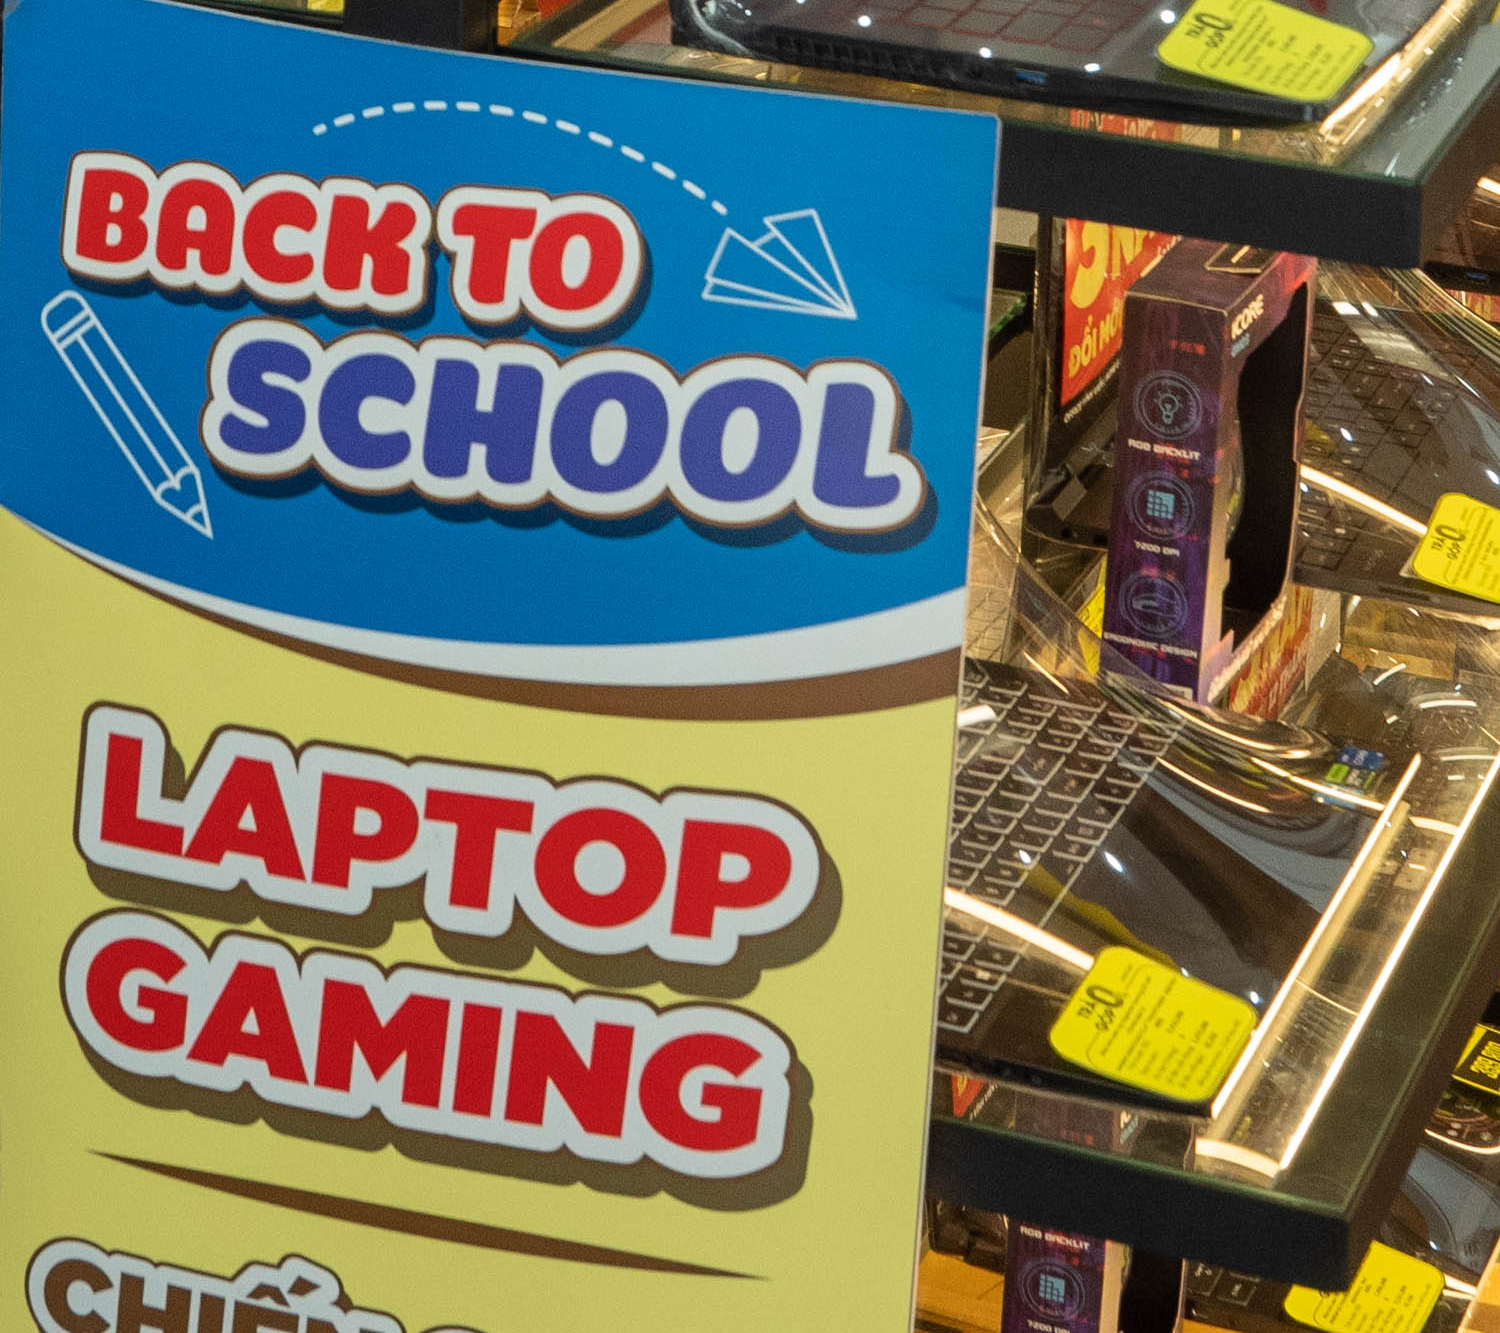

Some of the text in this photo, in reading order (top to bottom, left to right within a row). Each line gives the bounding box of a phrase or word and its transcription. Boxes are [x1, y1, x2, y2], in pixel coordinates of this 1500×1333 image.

[75, 166, 900, 512] BACK TO SCHOOL
[97, 733, 794, 941] LAPTOP
[83, 934, 764, 1152] GAMING
